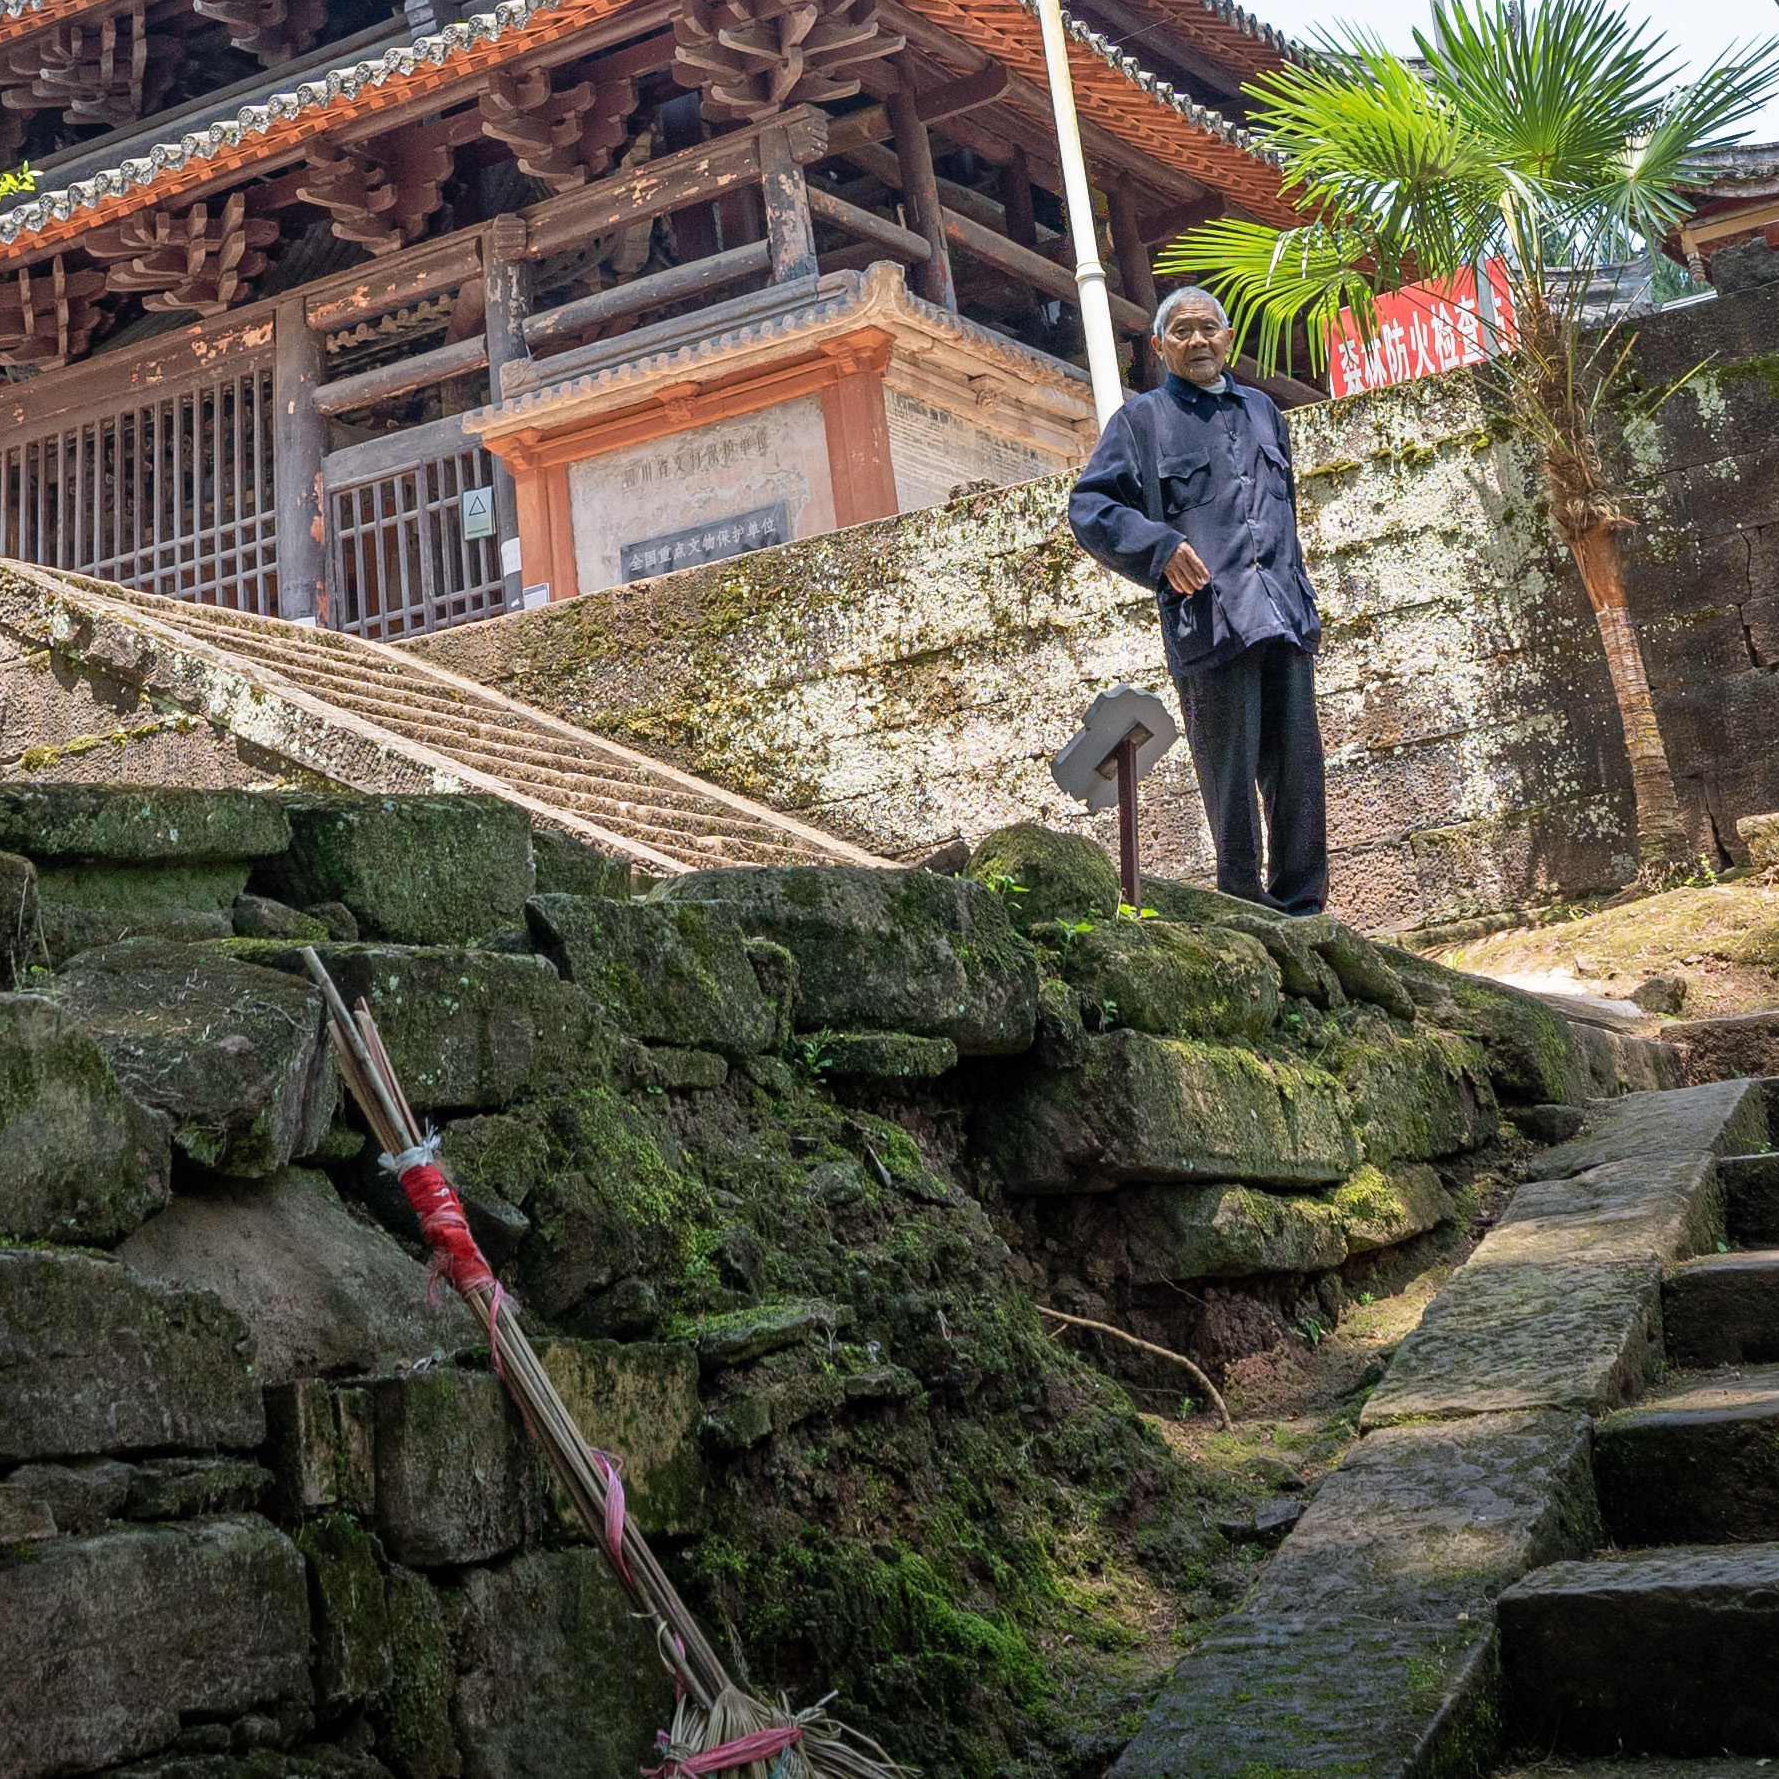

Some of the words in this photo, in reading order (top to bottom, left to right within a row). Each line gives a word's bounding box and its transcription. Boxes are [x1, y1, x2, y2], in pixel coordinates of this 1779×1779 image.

[623, 430, 768, 487] 四川省文物保护单位
[629, 517, 776, 571] 全国重点文物保护单位
